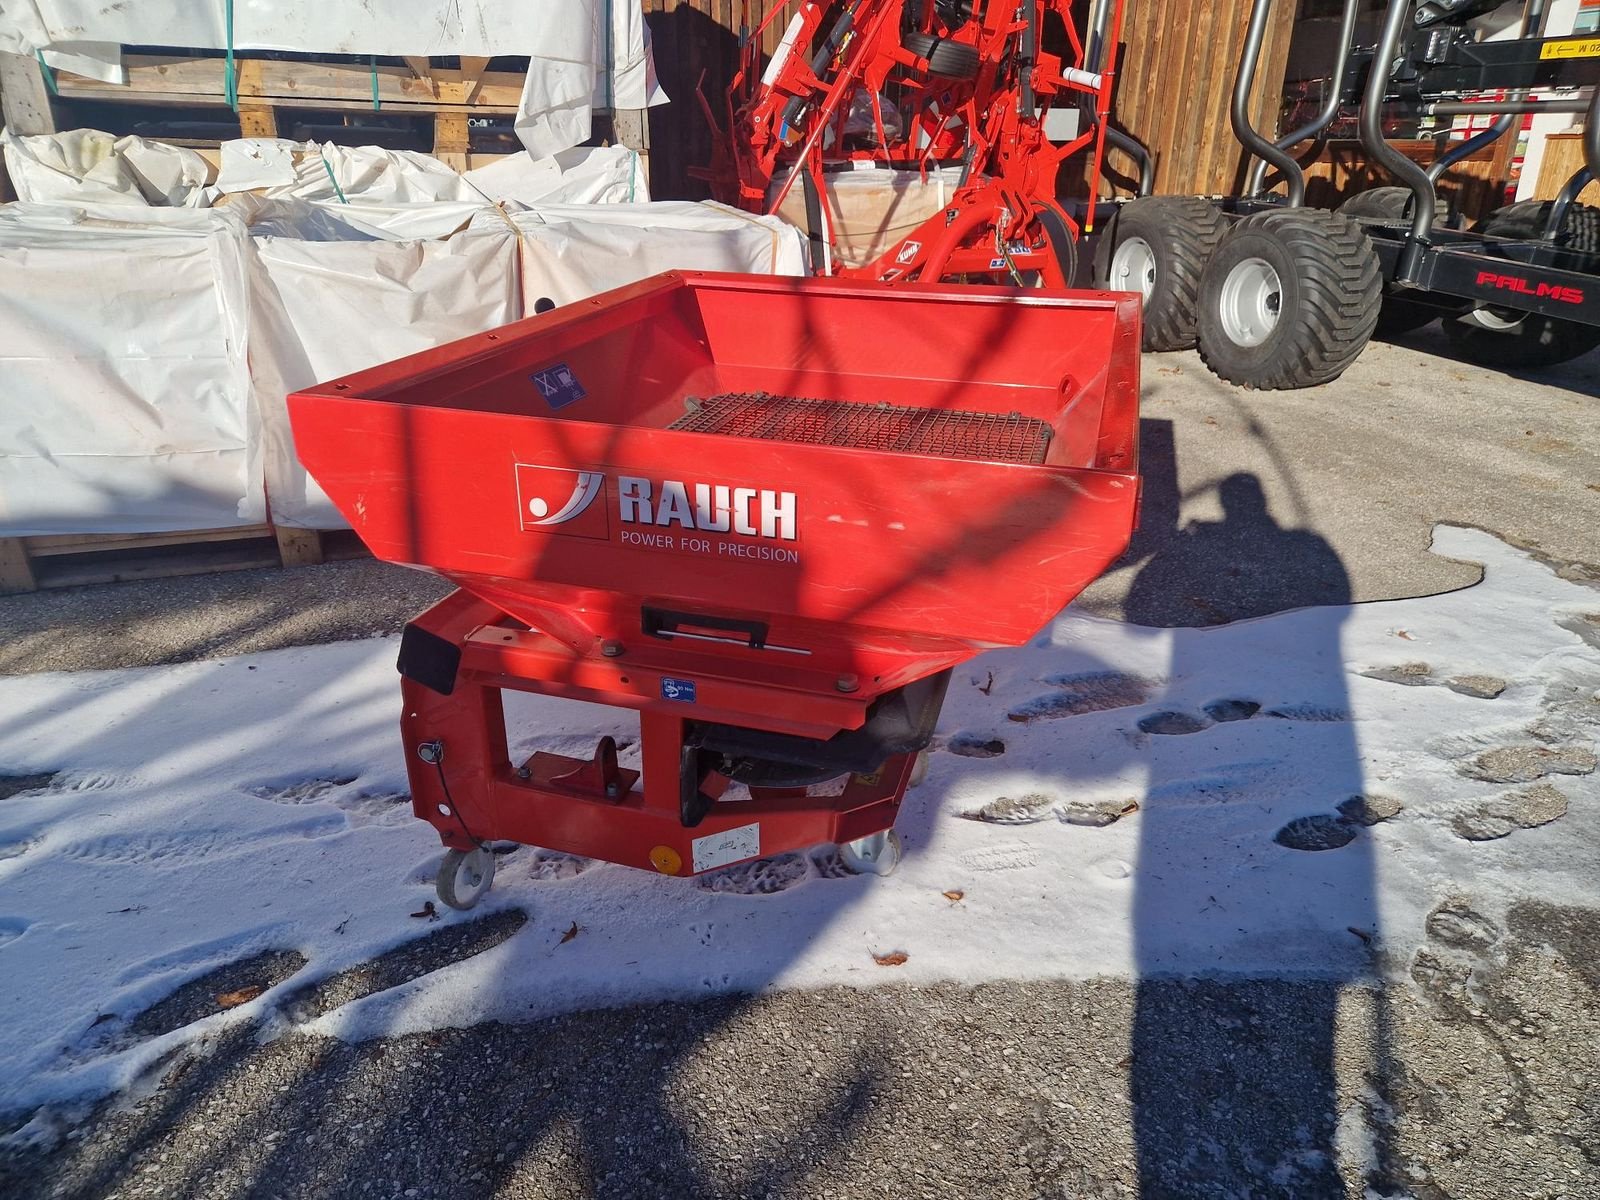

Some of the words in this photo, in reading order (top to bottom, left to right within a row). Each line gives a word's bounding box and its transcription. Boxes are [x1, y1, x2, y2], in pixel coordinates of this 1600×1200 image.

[900, 243, 918, 262] KUHN
[1475, 271, 1584, 304] PALMS
[618, 476, 797, 540] RAUCH
[621, 530, 674, 549] POWER
[681, 537, 711, 553] FOR
[719, 542, 798, 564] PRECISION
